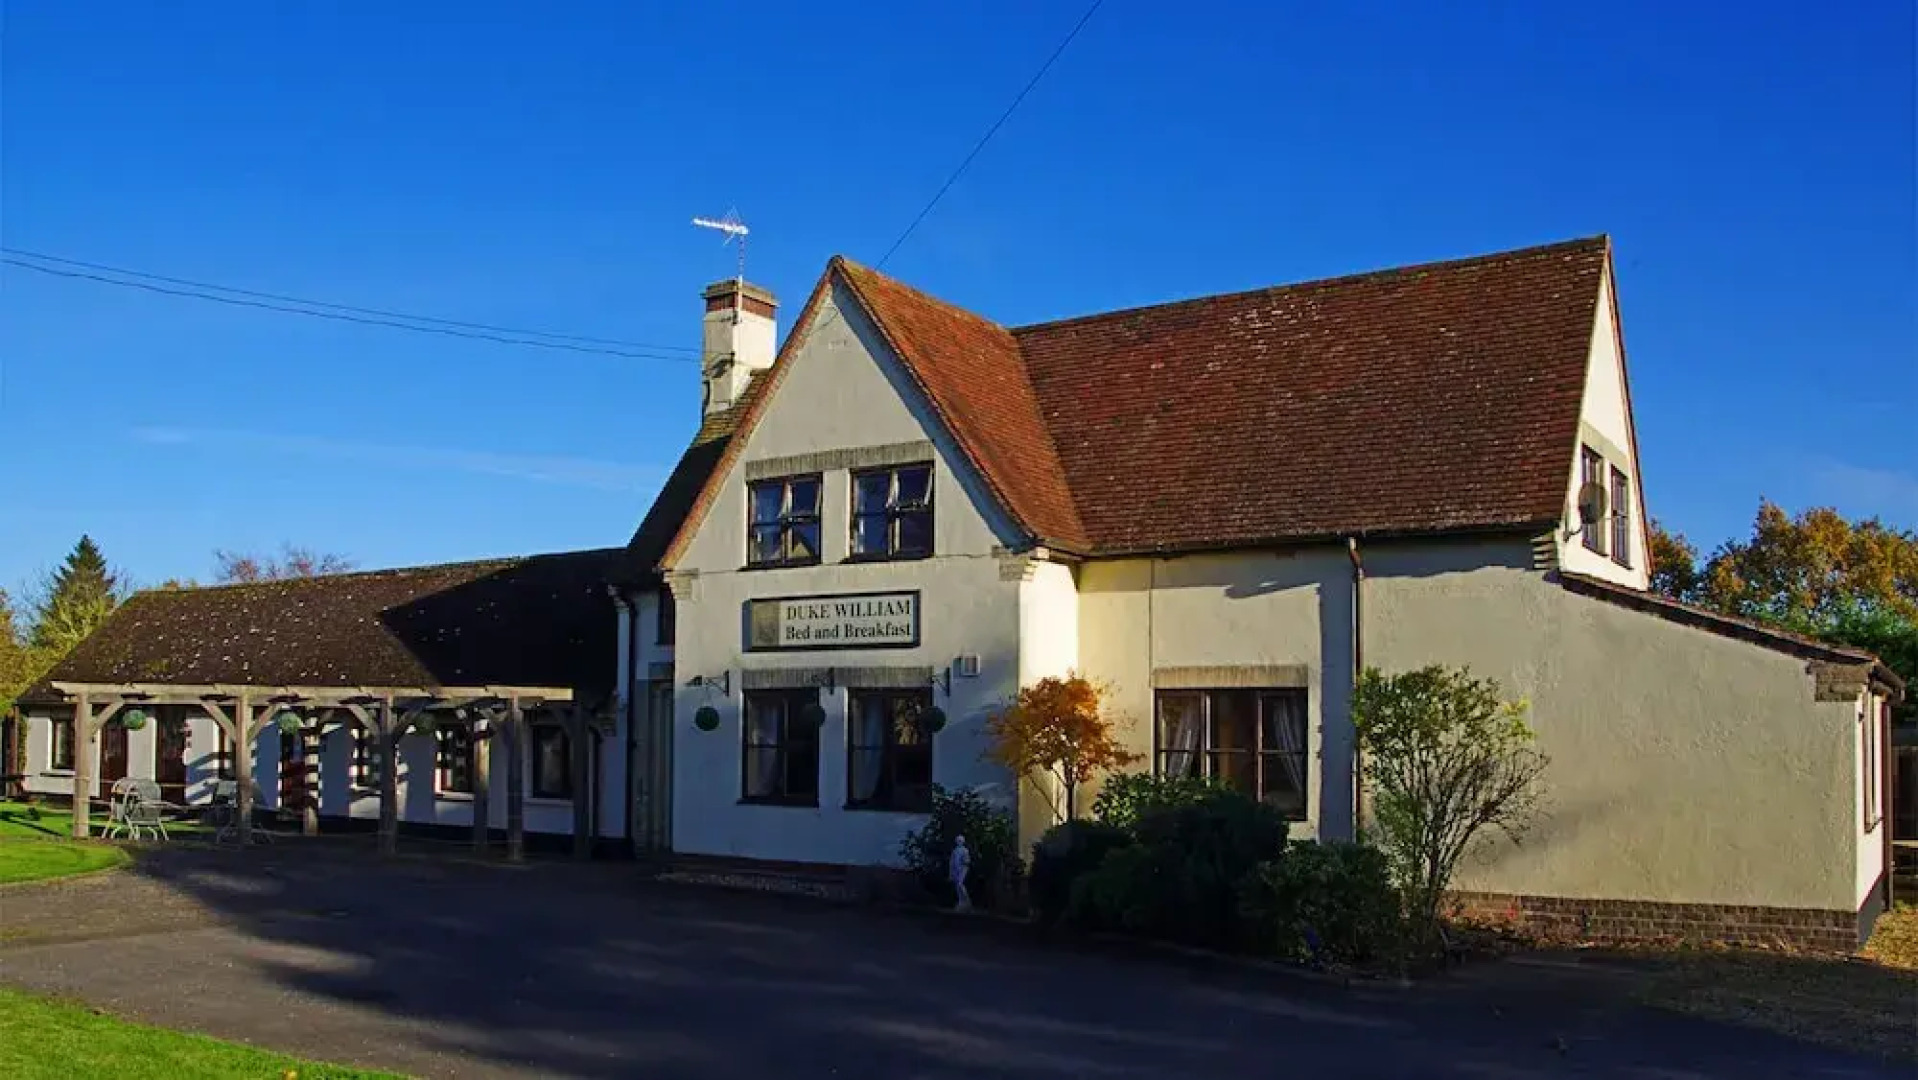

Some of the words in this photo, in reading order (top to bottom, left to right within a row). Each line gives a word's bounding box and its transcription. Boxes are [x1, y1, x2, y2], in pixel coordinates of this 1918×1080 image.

[786, 604, 830, 620] DUKE
[834, 600, 910, 618] WILLIAM
[786, 625, 810, 640] Bed
[814, 624, 839, 639] and
[845, 622, 910, 638] Breakfast
